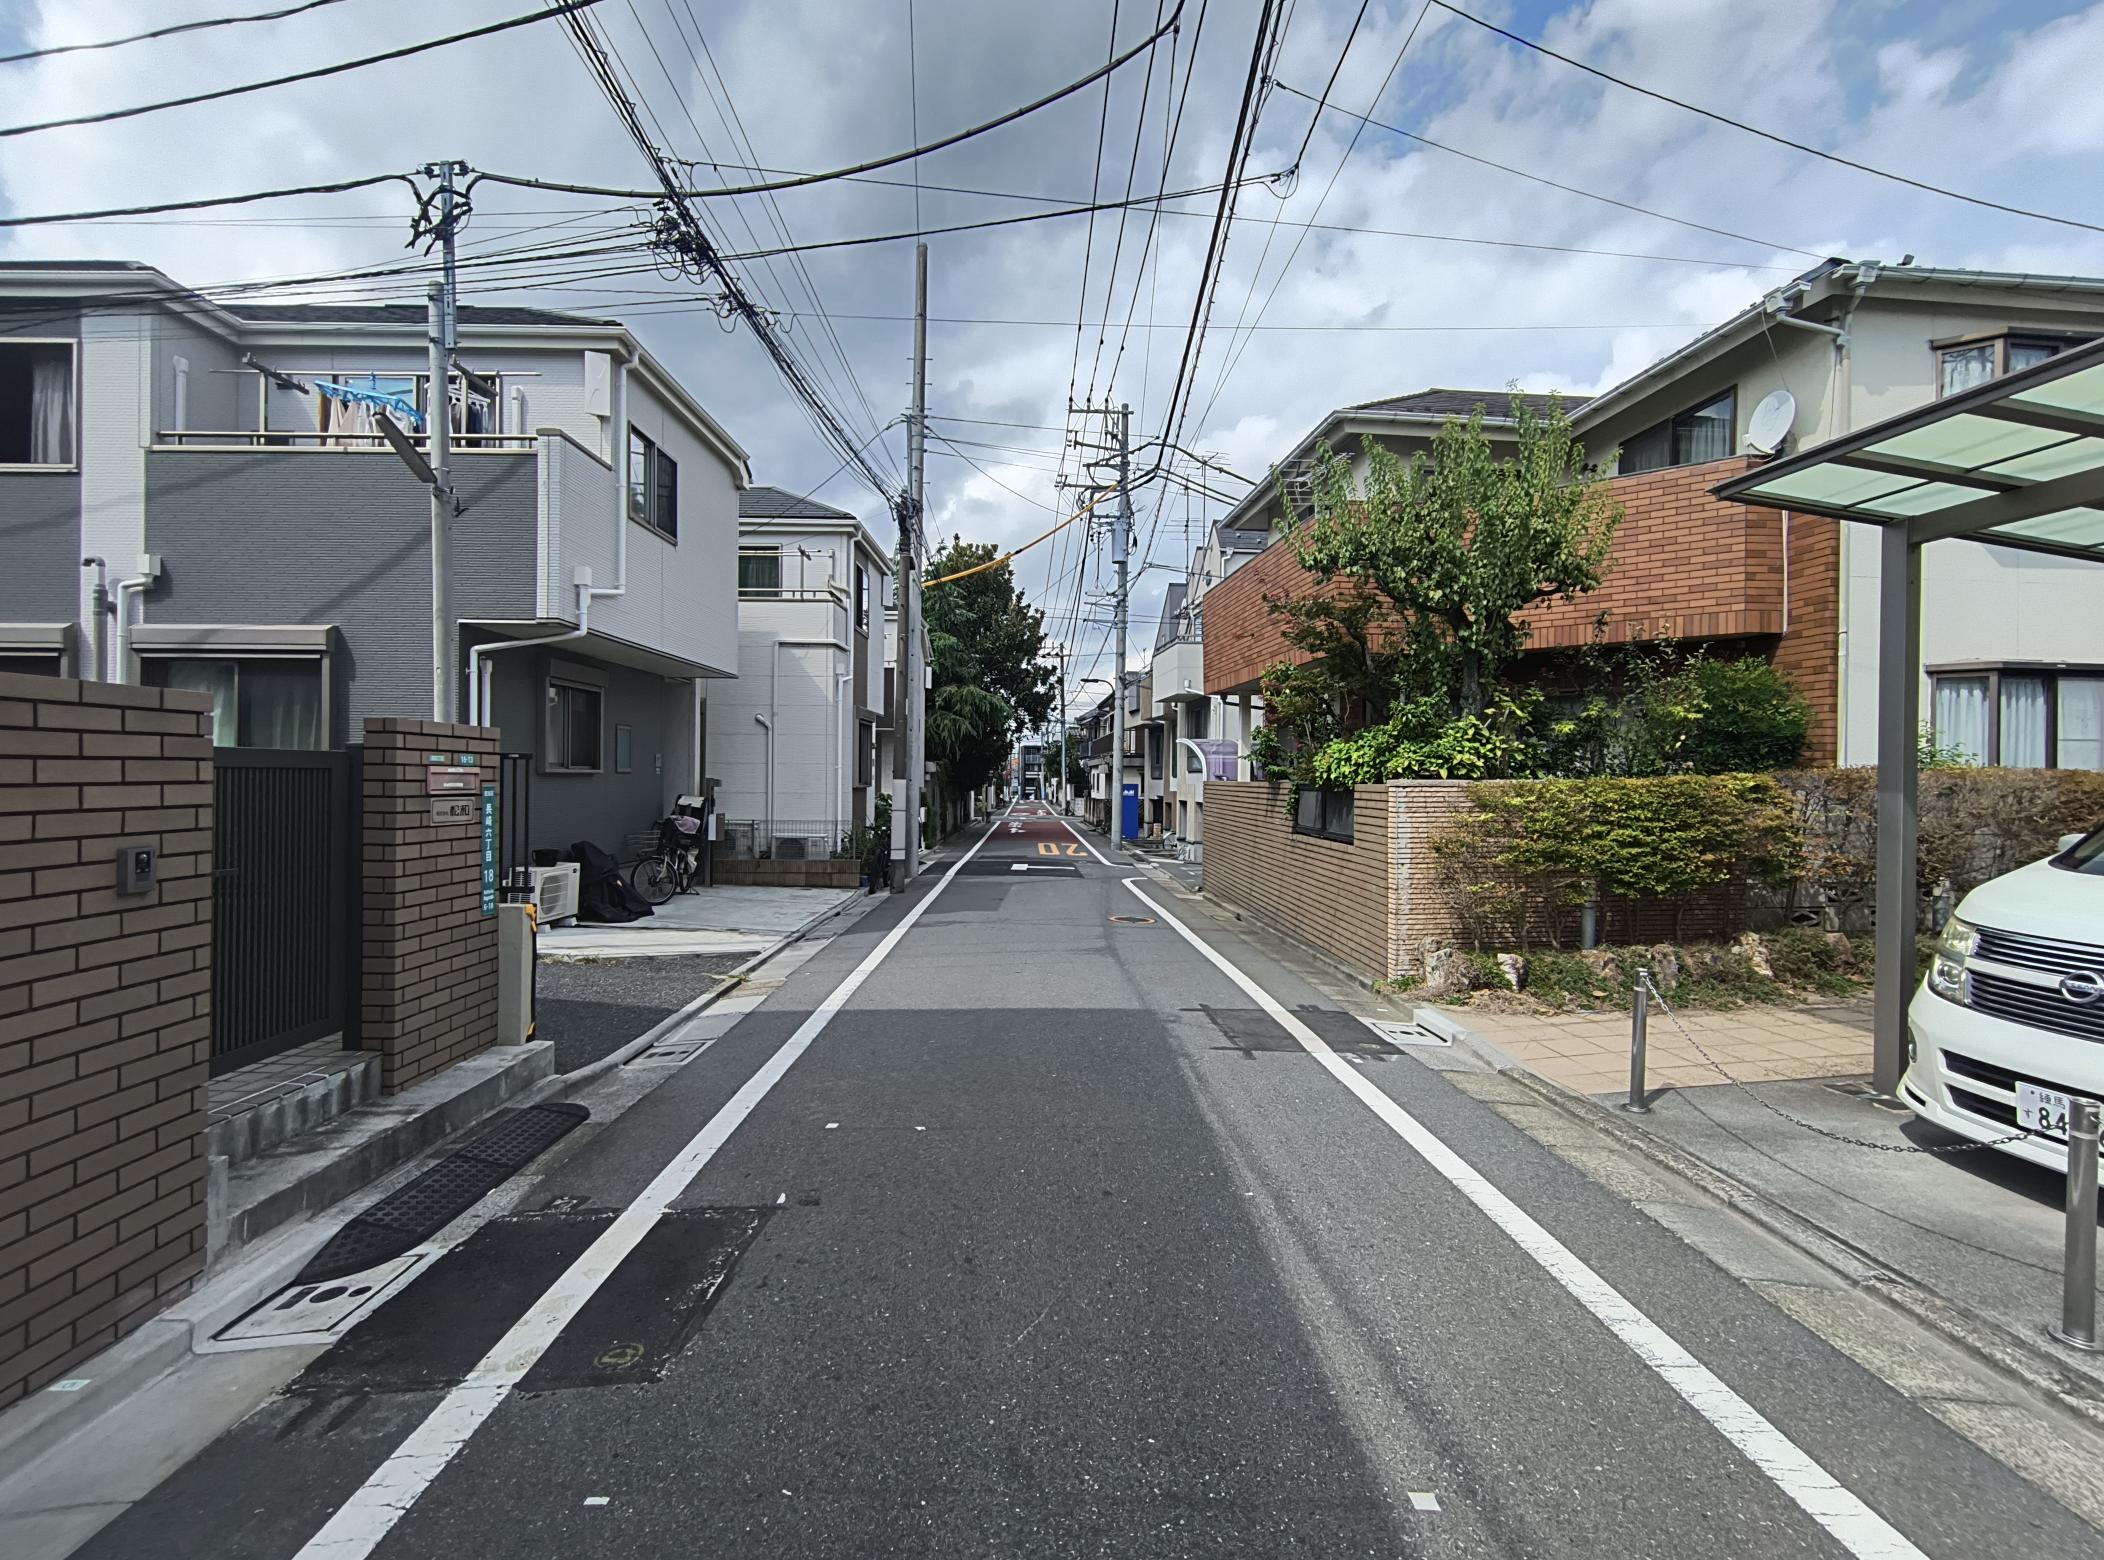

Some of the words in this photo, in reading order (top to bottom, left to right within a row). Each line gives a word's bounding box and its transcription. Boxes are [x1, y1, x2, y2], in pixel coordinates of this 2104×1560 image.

[485, 804, 493, 862] 長崎六丁目
[1038, 842, 1088, 857] 20
[483, 869, 494, 883] 18
[2039, 1092, 2066, 1110] 練馬
